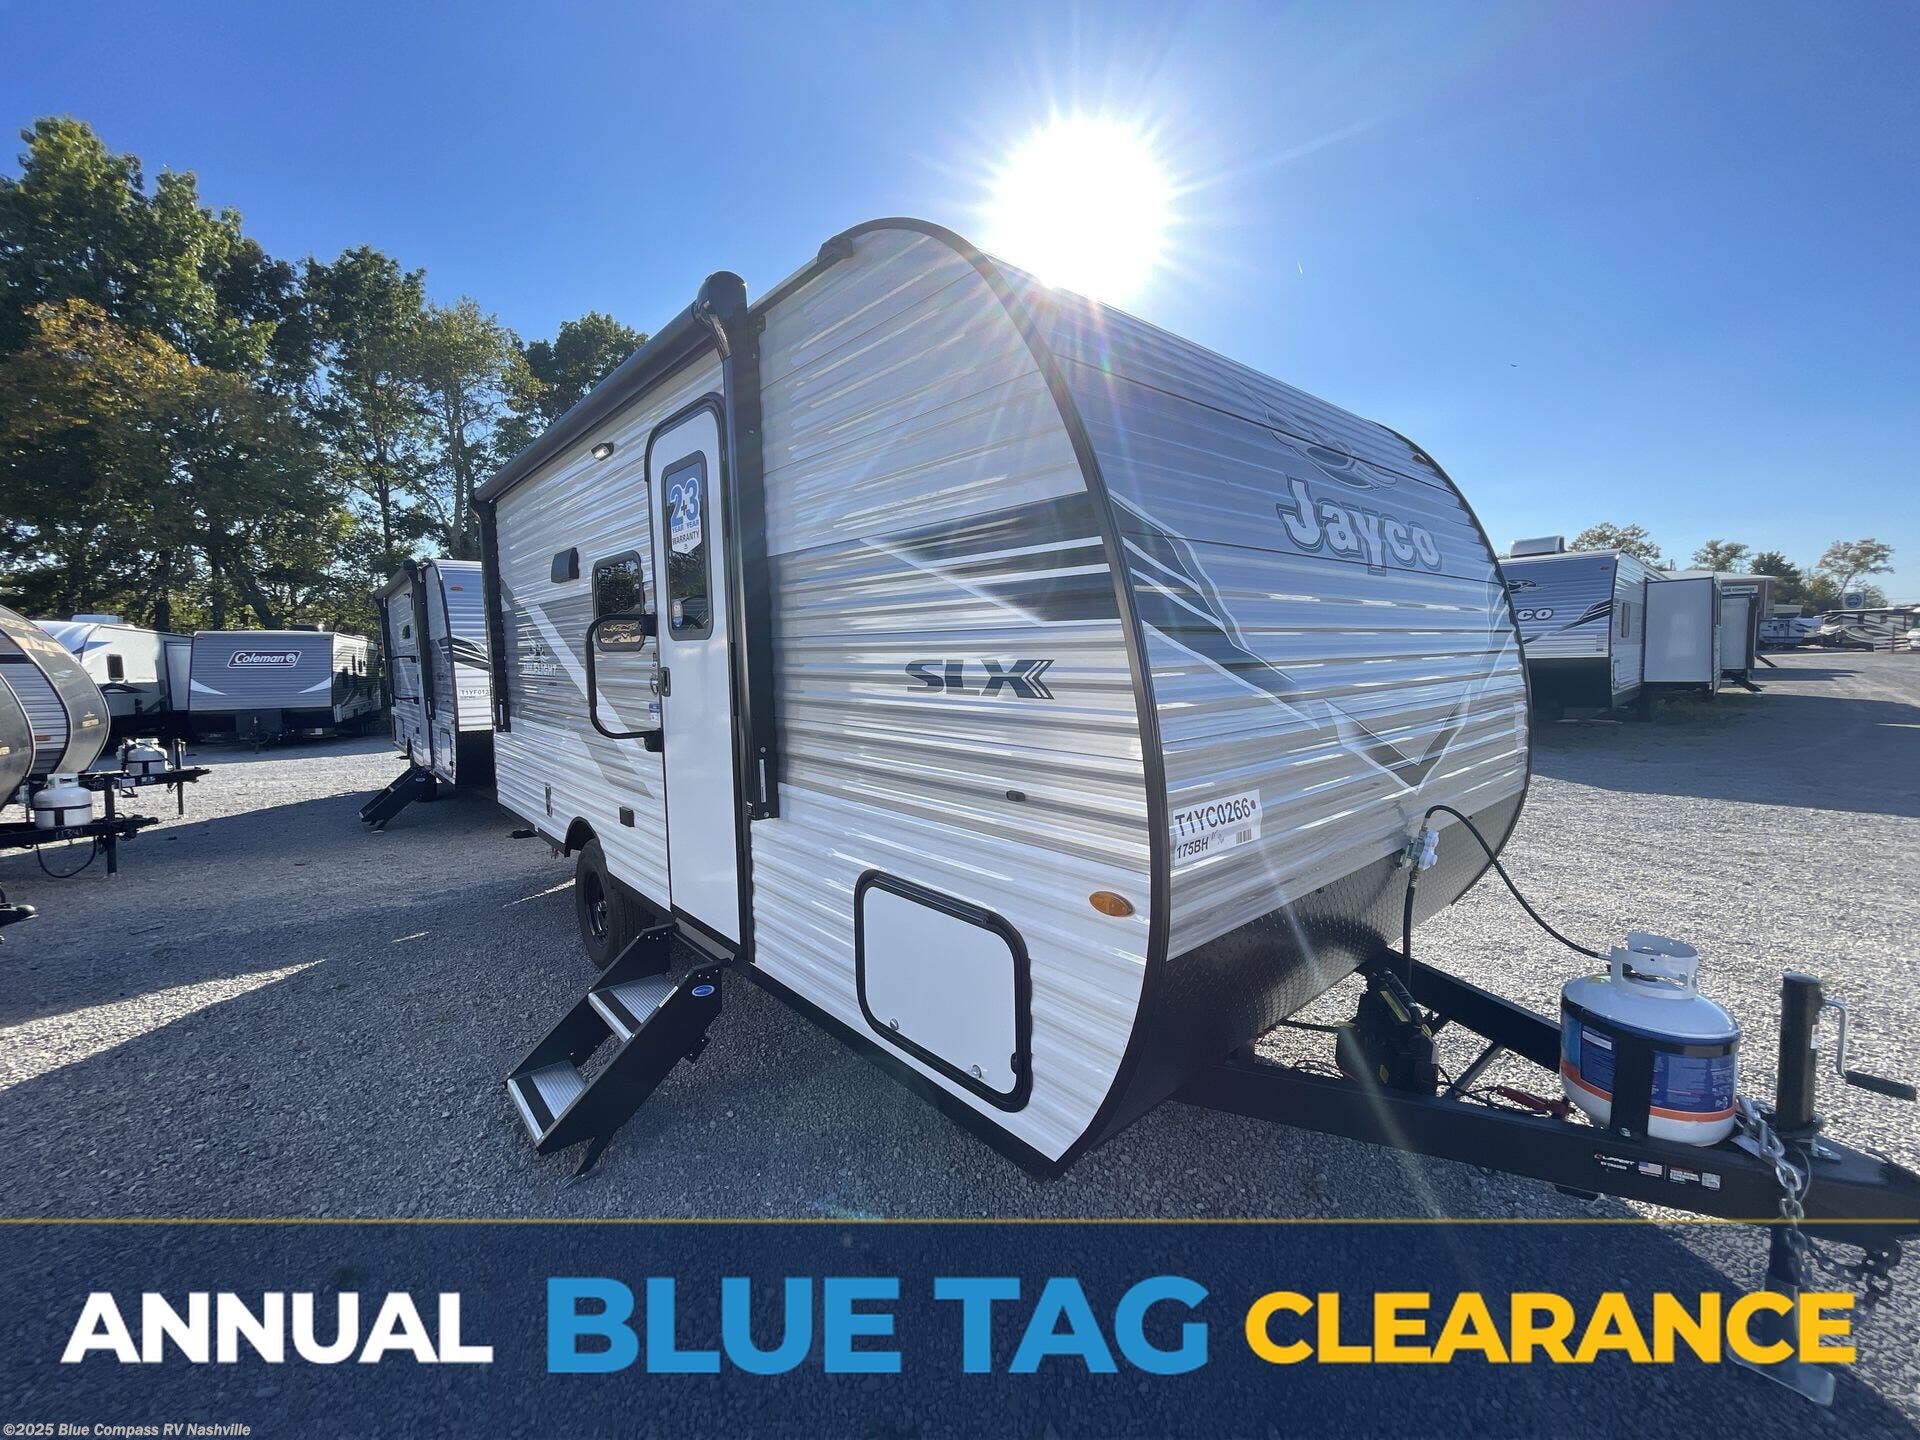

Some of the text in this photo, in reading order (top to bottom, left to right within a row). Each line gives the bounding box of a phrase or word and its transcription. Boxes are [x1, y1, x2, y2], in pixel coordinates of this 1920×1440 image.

[672, 529, 700, 545] WARRANTY
[1276, 476, 1442, 577] Jayco
[234, 652, 285, 664] Coleman
[904, 659, 1054, 699] SLX
[1174, 797, 1251, 836] T1YC0266
[1176, 836, 1209, 859] 175BH
